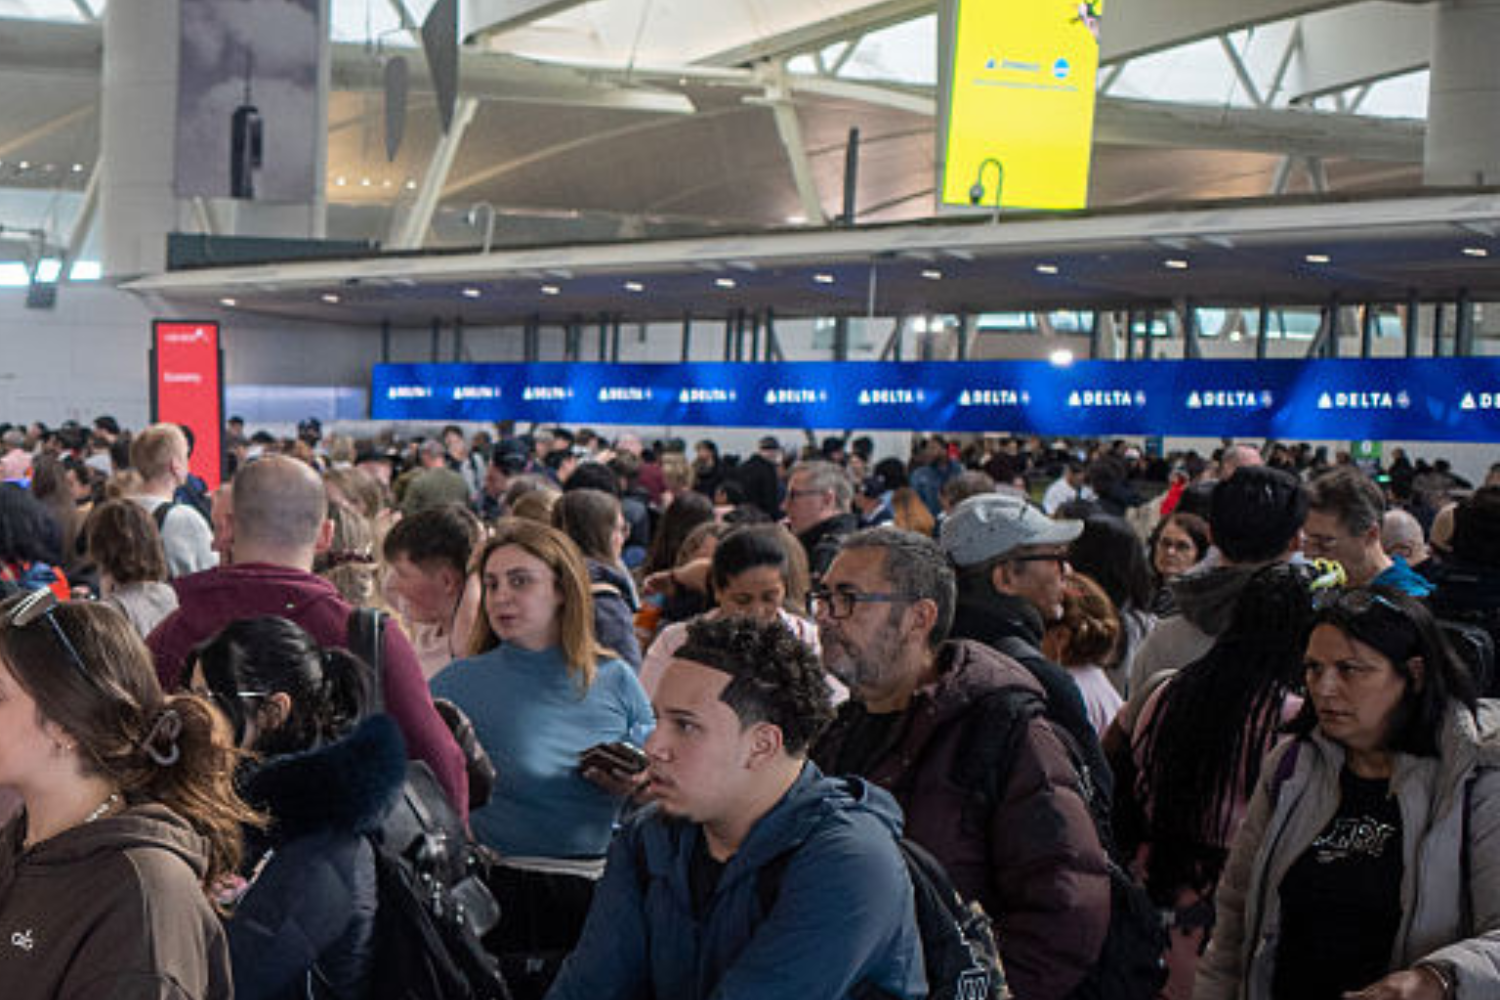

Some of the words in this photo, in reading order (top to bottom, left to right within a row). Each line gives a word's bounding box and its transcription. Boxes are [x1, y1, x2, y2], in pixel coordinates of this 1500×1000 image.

[872, 389, 914, 404] DELTA
[972, 389, 1018, 406] DELTA
[1083, 390, 1132, 407] DELTA
[1202, 391, 1258, 407] DELTA
[1334, 392, 1393, 407] DELTA
